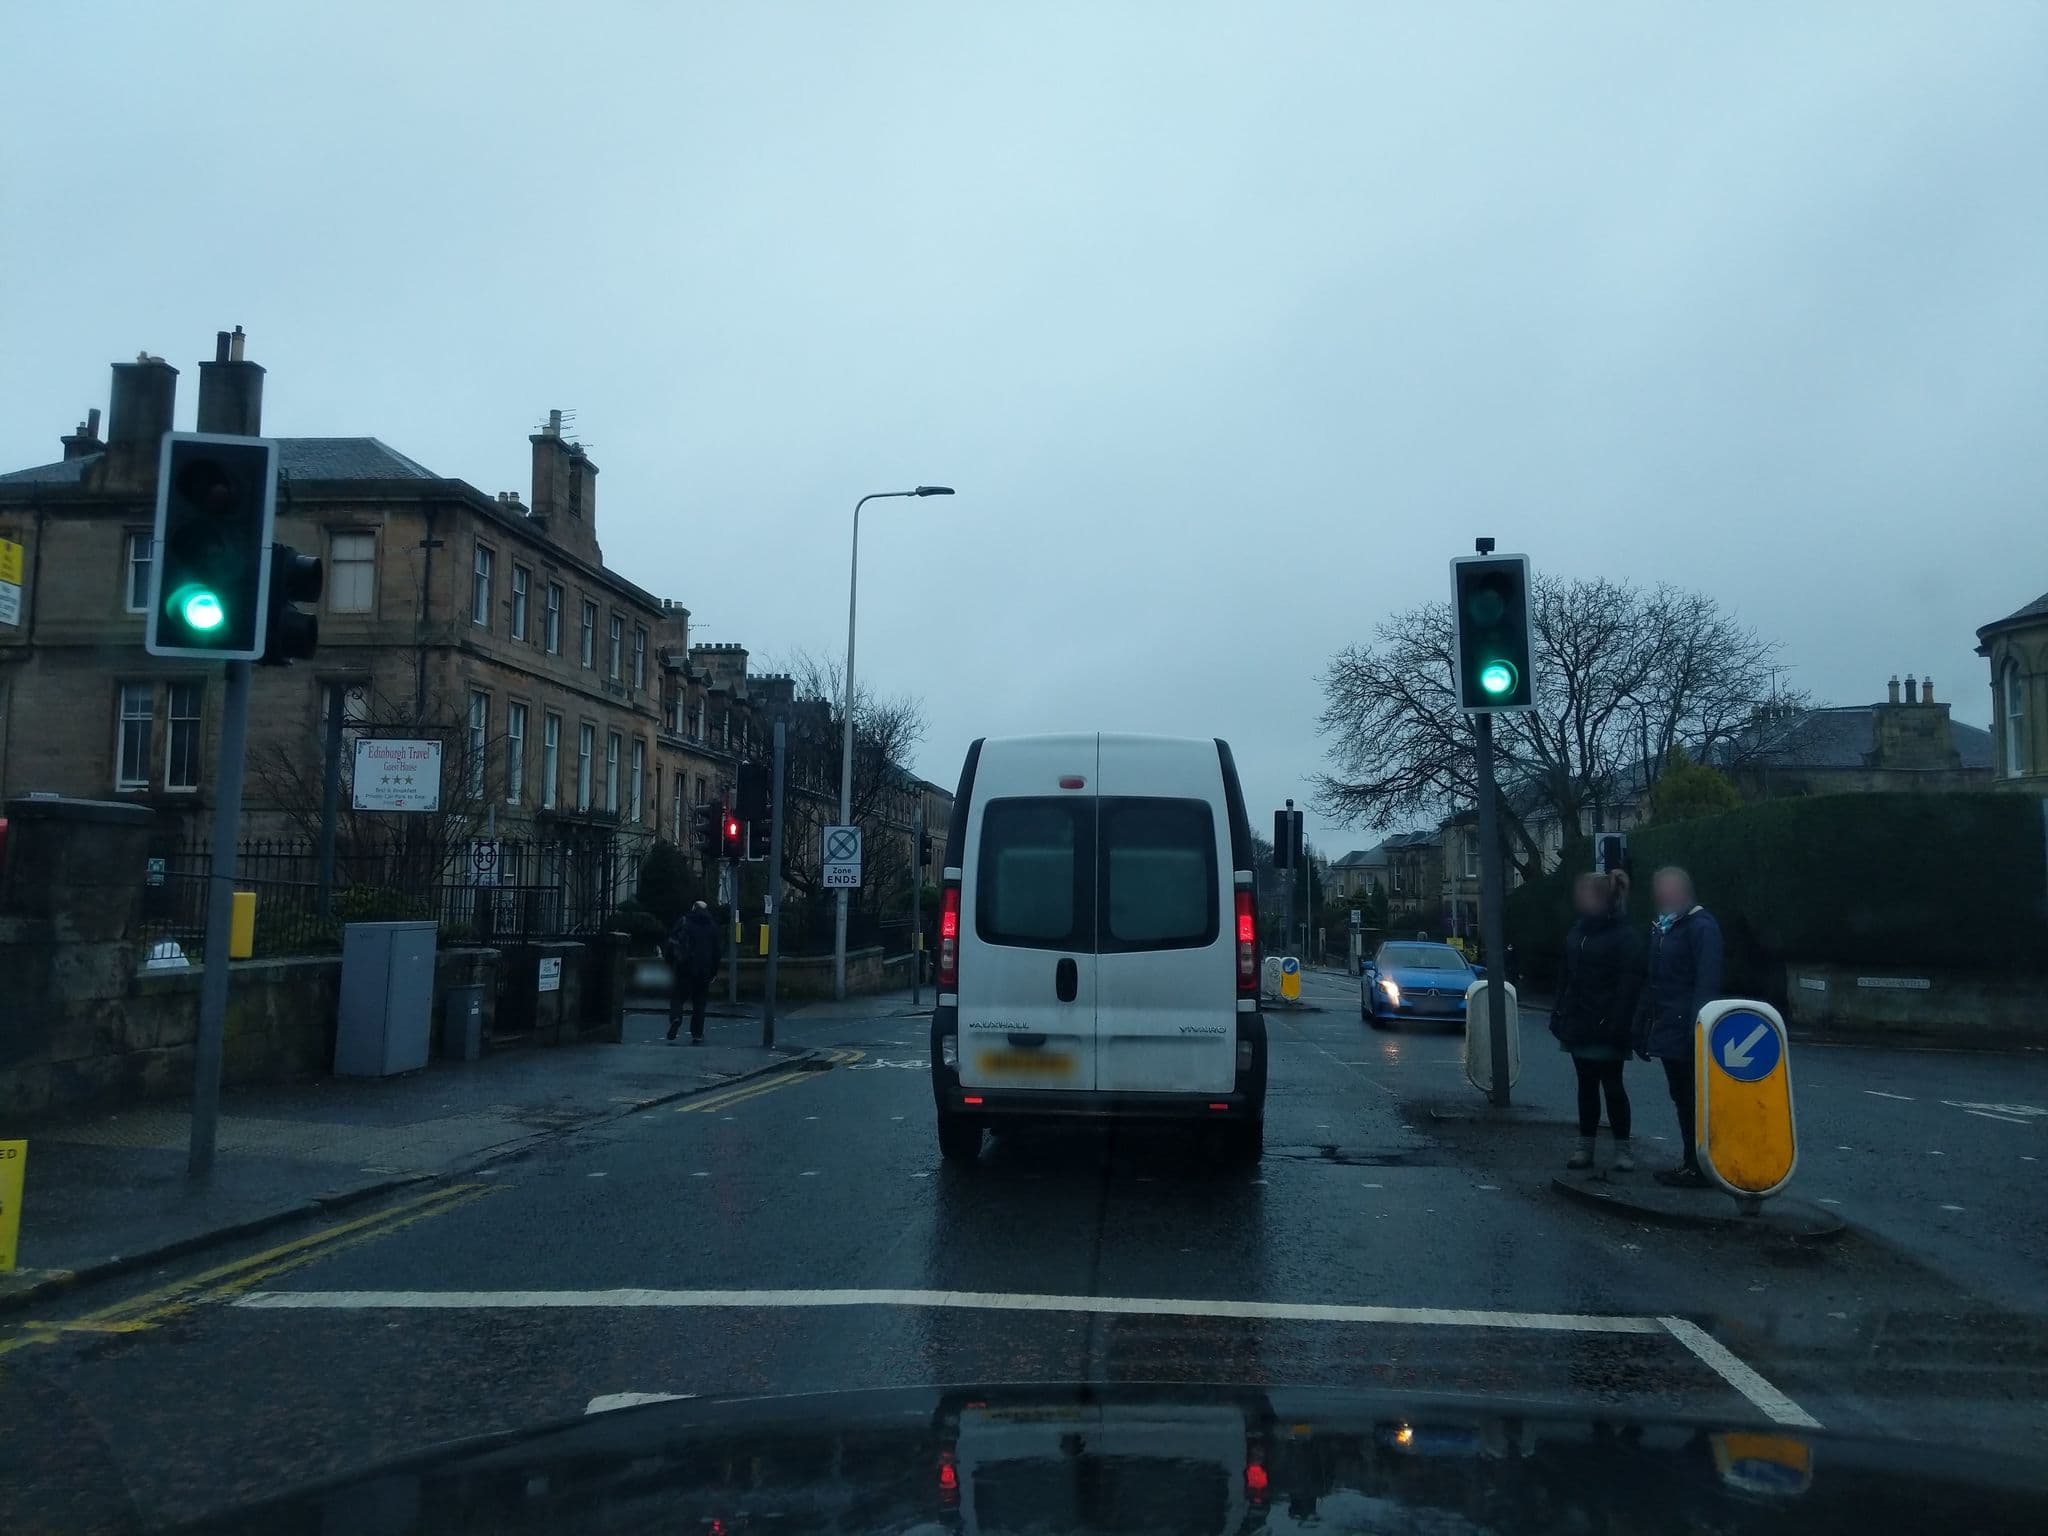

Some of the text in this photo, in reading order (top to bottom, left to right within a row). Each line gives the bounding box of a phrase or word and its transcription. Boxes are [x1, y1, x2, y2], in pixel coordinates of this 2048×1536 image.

[368, 745, 430, 763] Edinburgh Travel
[400, 762, 417, 771] House
[478, 852, 493, 863] 30
[827, 875, 857, 884] ENDS
[969, 1021, 1030, 1029] VAUXHALL
[1178, 1025, 1227, 1034] VIVARO
